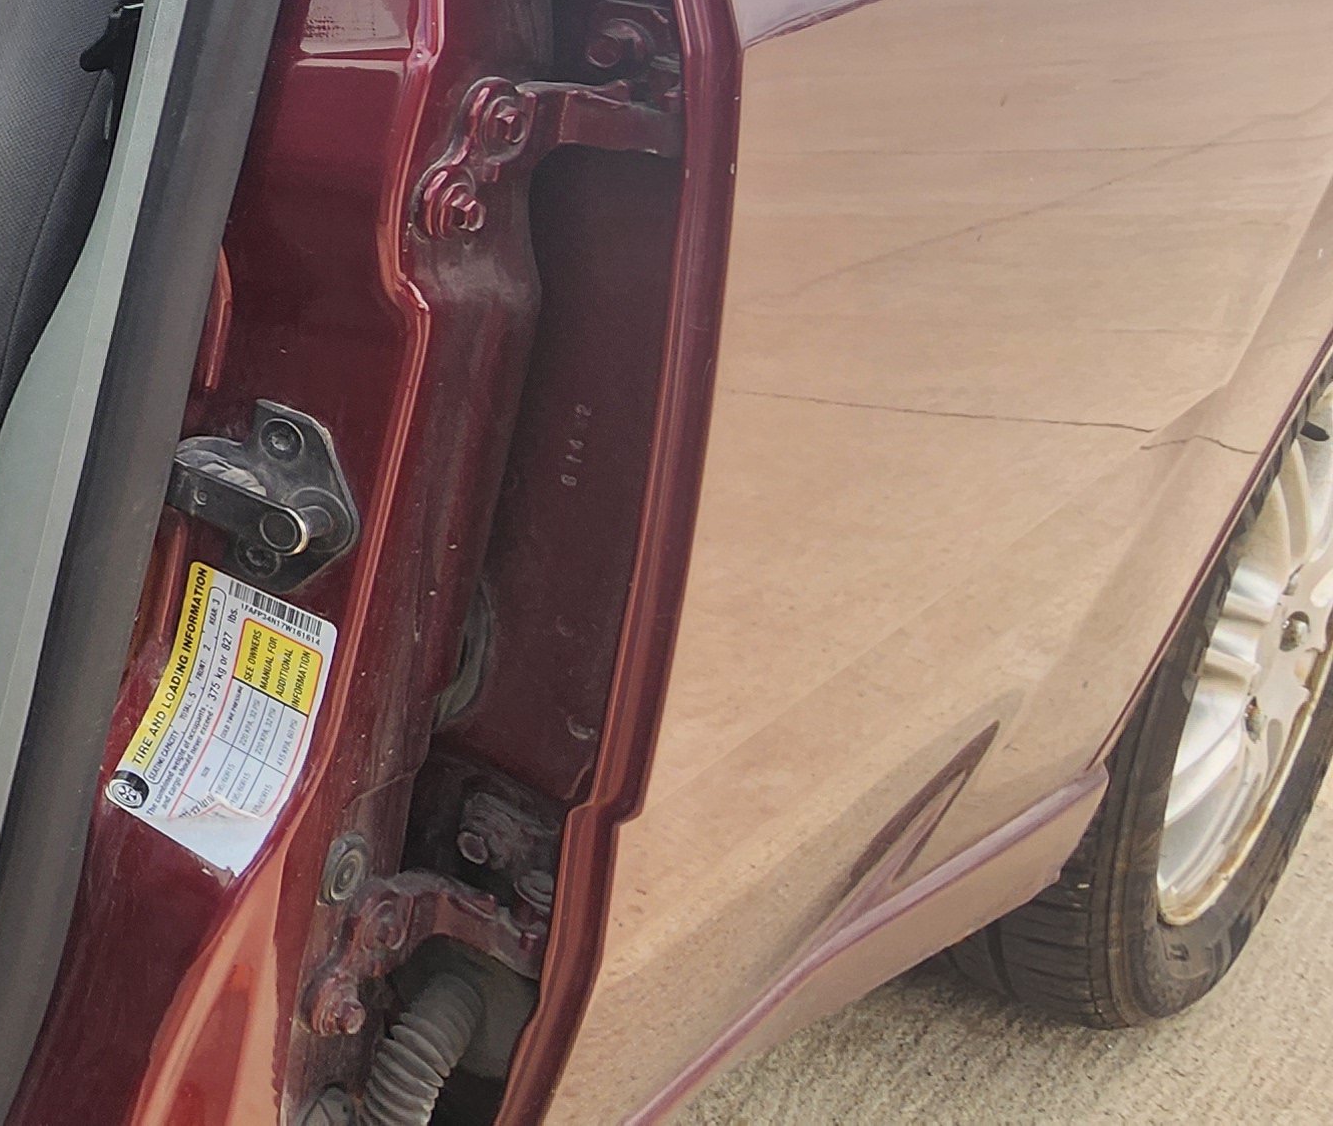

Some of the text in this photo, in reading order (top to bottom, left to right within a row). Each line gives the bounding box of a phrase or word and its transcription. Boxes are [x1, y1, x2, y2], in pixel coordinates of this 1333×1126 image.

[212, 598, 221, 606] 3
[132, 567, 208, 765] TIRE AND LOADING INFORMATION
[207, 608, 239, 702] 375 kg or 827 lbs.
[244, 629, 262, 682] SEE OWNERS
[259, 636, 278, 691] MANUAL FOR
[275, 648, 294, 698] ADDITIONAL
[291, 650, 311, 709] INFORMATION
[188, 691, 197, 699] 5
[146, 805, 156, 816] The
[155, 770, 172, 805] combined
[173, 748, 187, 772] weight
[188, 706, 206, 740] occupants
[148, 730, 180, 780] SEATING CAPACITY
[161, 798, 170, 810] and
[169, 779, 181, 799] cargo
[178, 753, 194, 777] should
[191, 735, 203, 755] never
